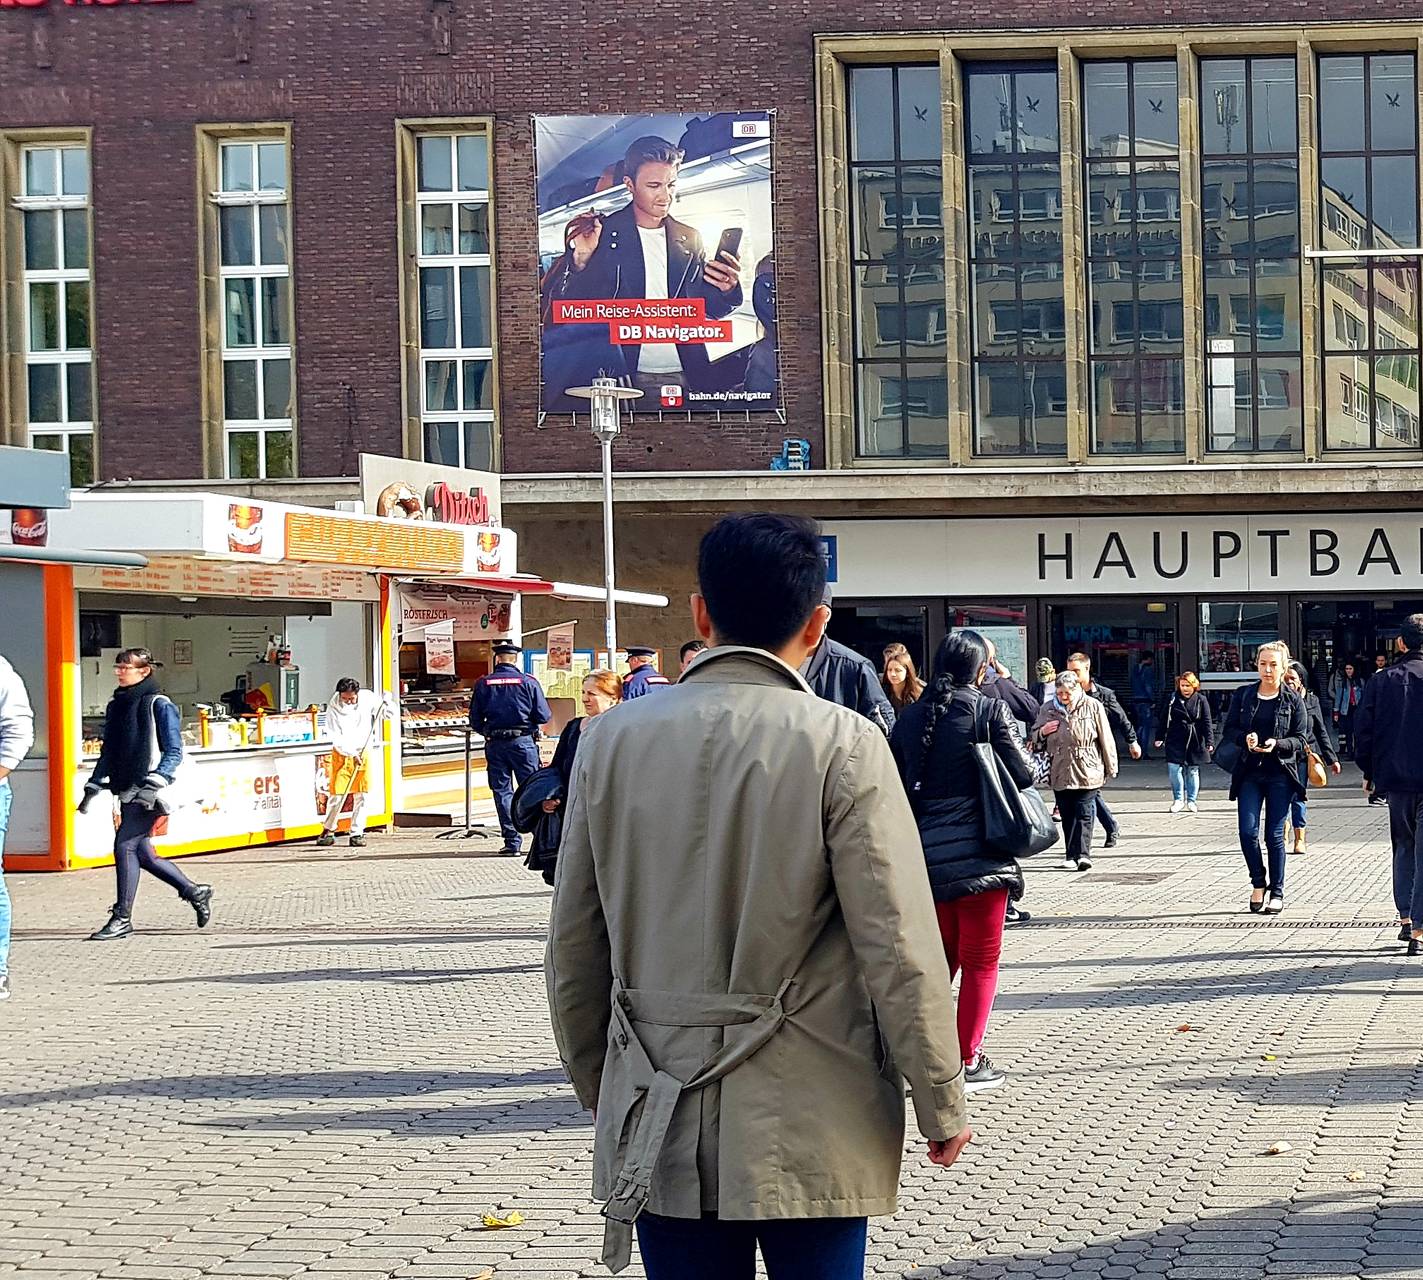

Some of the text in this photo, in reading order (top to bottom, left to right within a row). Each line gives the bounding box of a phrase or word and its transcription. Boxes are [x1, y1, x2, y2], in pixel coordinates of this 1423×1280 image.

[561, 304, 697, 319] Mein Reise-Assistent:
[619, 324, 724, 341] DB Navigator.
[688, 391, 771, 402] bahn.de/navigator
[429, 481, 490, 526] Ditsch
